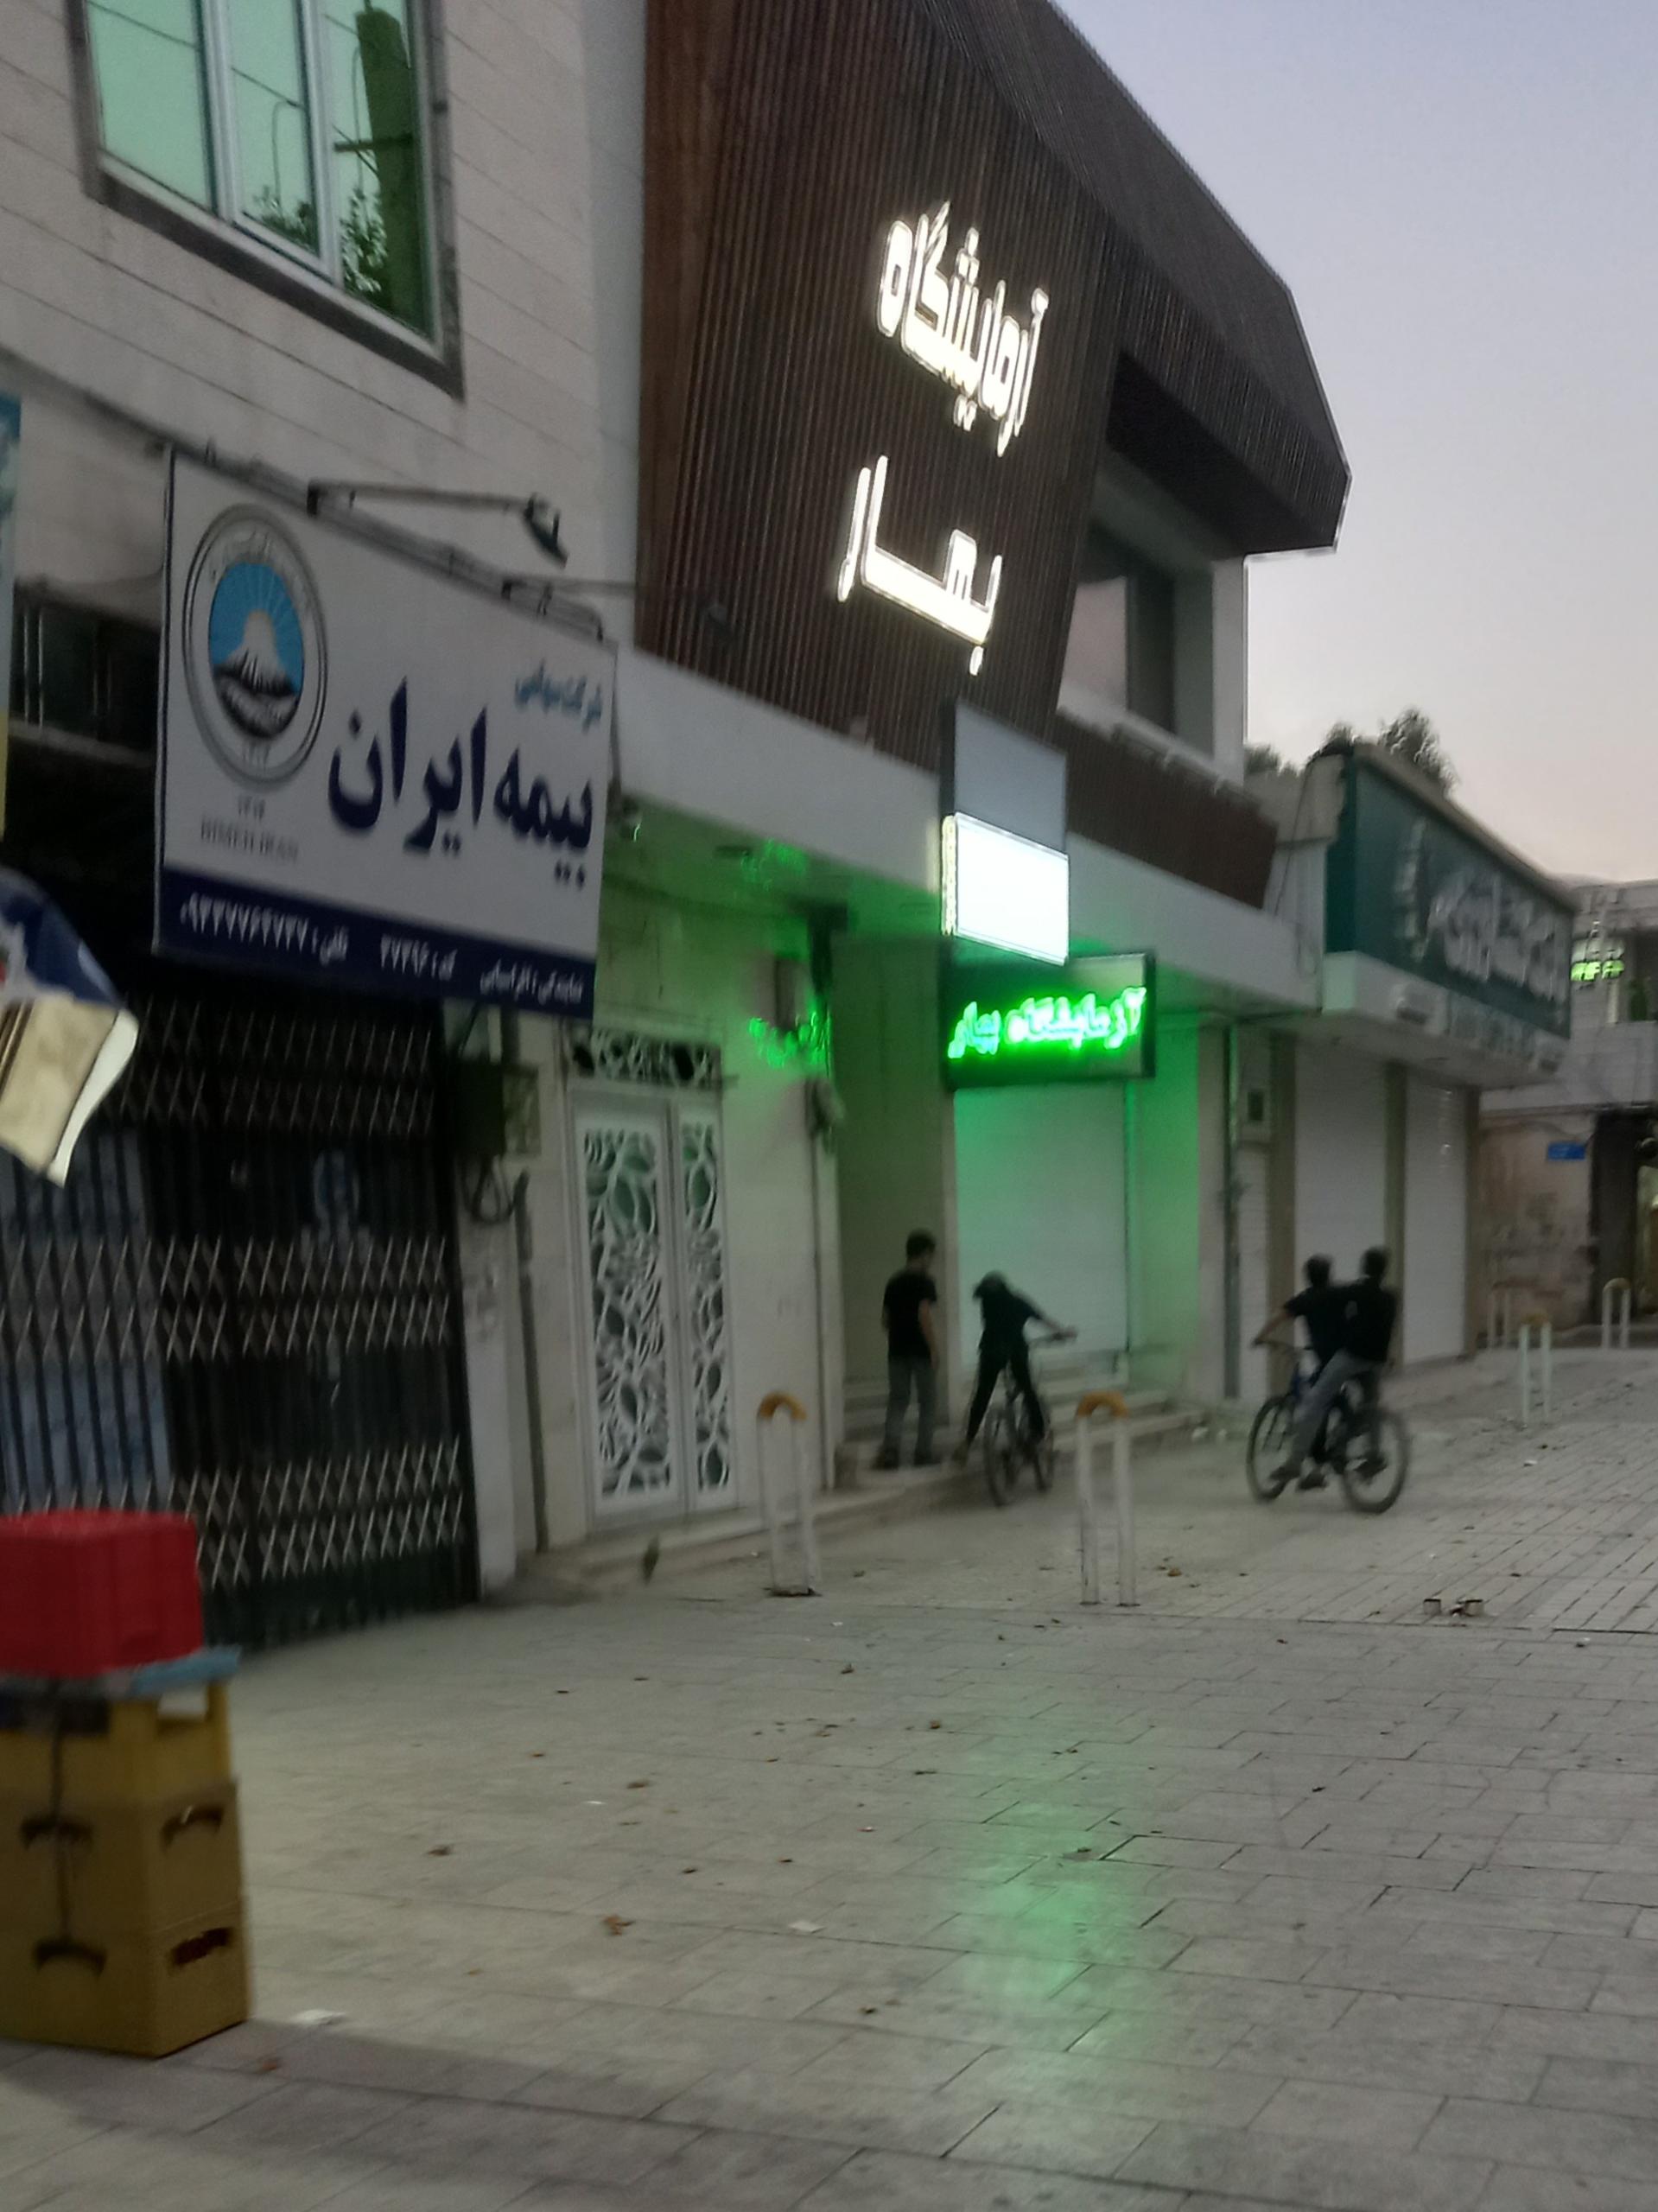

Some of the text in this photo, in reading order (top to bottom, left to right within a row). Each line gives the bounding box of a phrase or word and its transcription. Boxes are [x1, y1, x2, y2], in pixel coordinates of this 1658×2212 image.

[835, 454, 1003, 676] بهار
[327, 673, 594, 891] بیمه ایران
[1004, 986, 1147, 1051] آزمایشگاه
